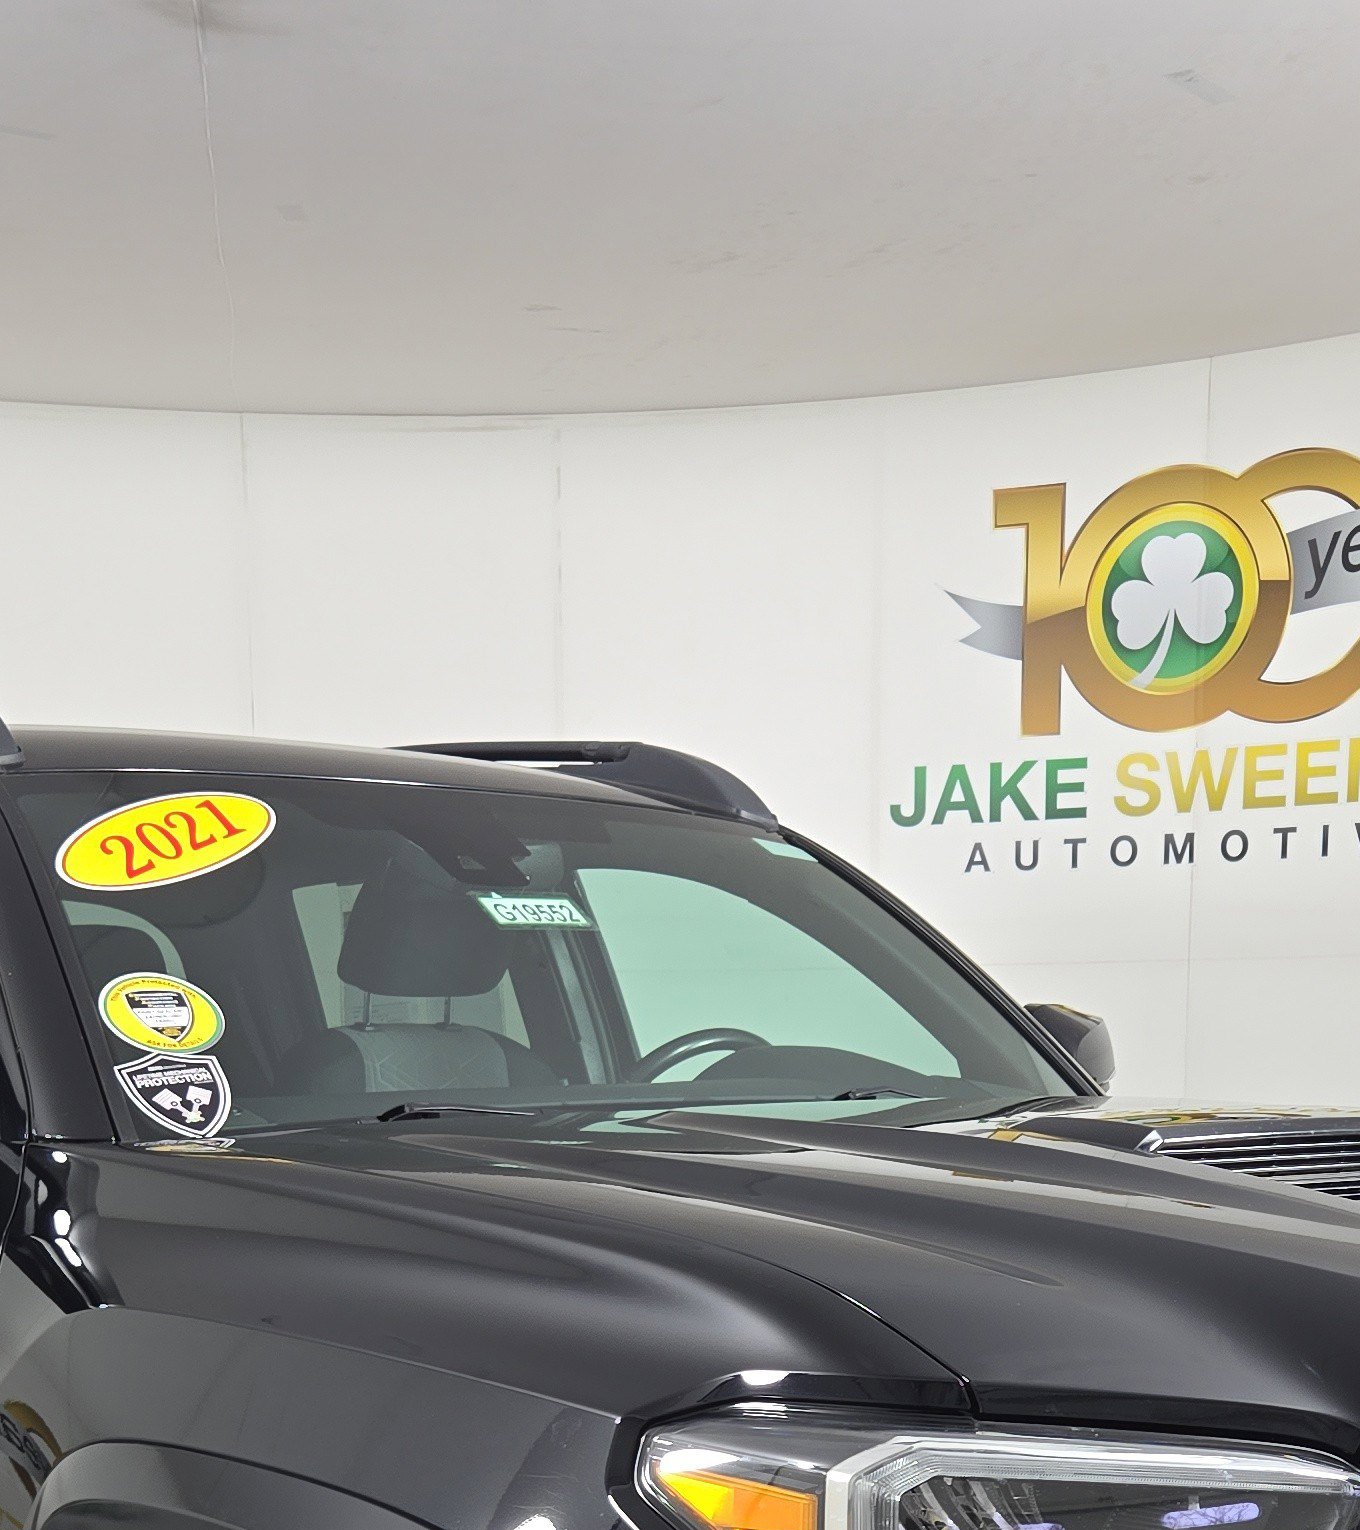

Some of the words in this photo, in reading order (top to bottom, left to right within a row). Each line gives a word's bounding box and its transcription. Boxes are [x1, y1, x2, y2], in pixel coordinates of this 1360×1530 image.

[889, 757, 1089, 827] JAKE
[99, 799, 247, 879] 2021
[493, 903, 582, 923] G19552
[135, 1072, 213, 1089] PROTECTION
